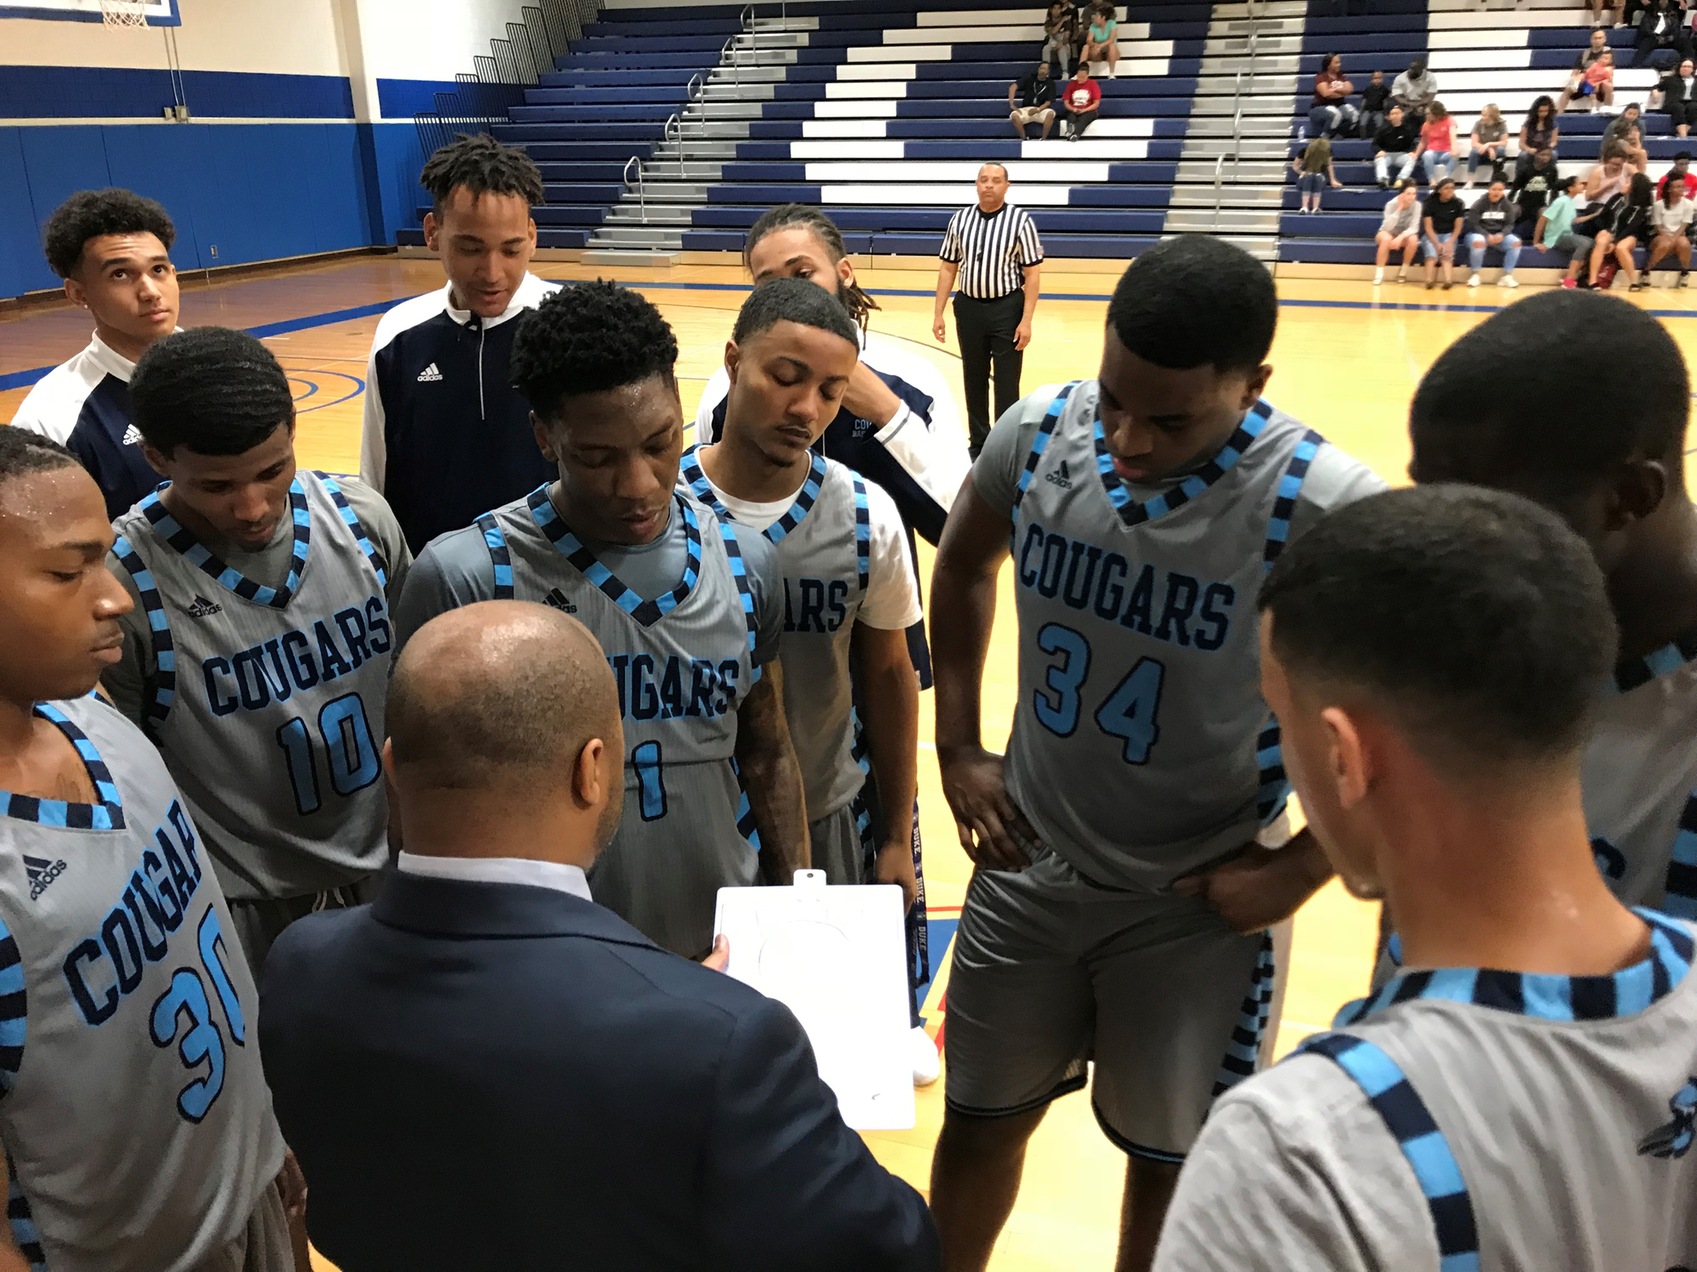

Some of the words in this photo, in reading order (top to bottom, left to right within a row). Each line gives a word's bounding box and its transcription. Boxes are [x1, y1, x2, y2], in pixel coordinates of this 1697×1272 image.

[417, 374, 443, 382] adidas
[1045, 473, 1073, 490] adidas
[188, 603, 223, 618] adidas
[1020, 522, 1236, 652] COUGARS
[201, 595, 392, 717] COUGARS
[1033, 621, 1166, 766] 34
[275, 691, 383, 817] 10
[631, 739, 668, 822] 1
[30, 859, 67, 901] adidas
[918, 926, 927, 952] DUKE
